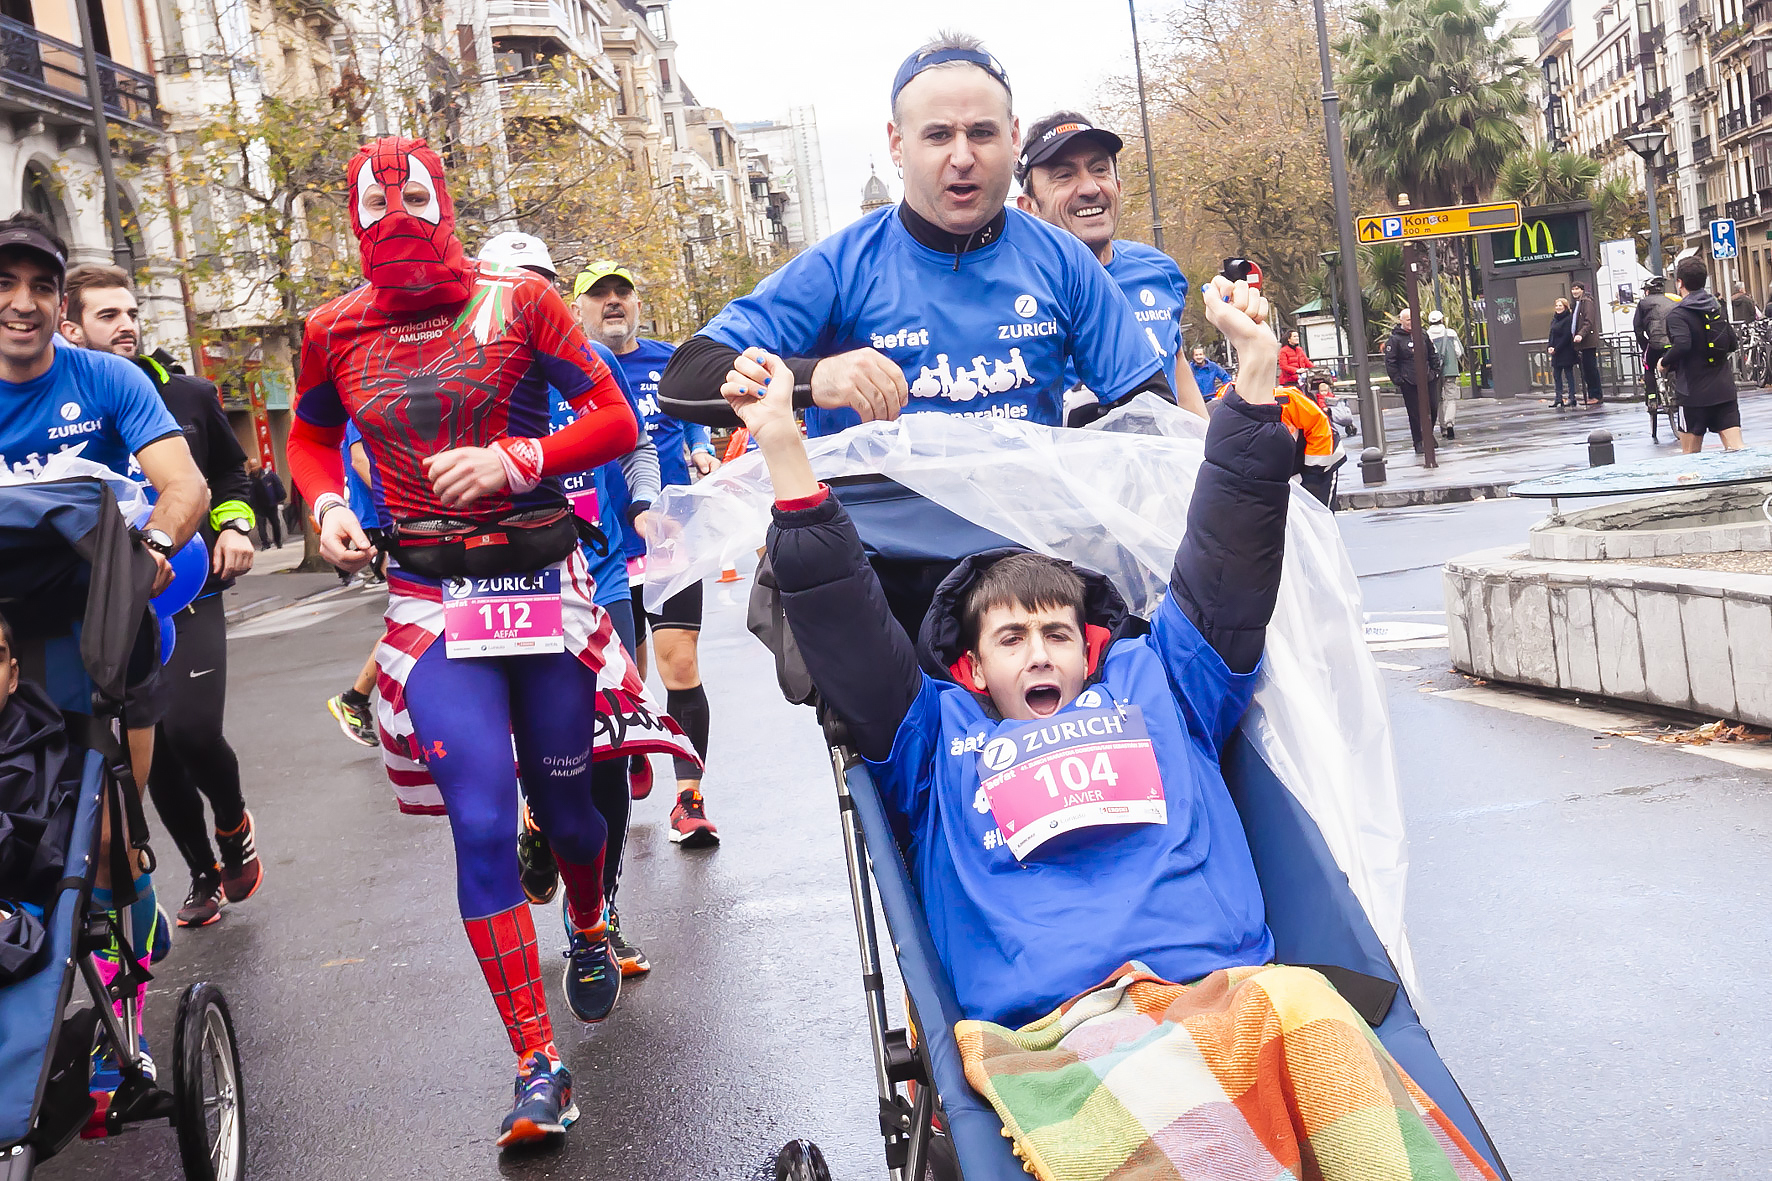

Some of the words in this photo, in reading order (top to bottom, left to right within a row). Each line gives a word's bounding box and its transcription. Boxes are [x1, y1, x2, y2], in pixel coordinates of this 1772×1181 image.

[1043, 128, 1057, 142] XIV
[1386, 219, 1400, 237] P
[1717, 223, 1730, 239] P
[1134, 309, 1171, 322] ZURICH
[399, 329, 442, 343] AMURRIO
[872, 328, 929, 349] aefat
[998, 321, 1057, 339] ZURICH
[48, 419, 101, 440] ZURICH
[477, 576, 544, 592] ZURICH
[478, 602, 532, 630] 112
[493, 629, 518, 639] AEFAT
[1022, 715, 1123, 752] ZURICH
[1034, 752, 1118, 798] 104
[1063, 789, 1104, 808] JAVIER
